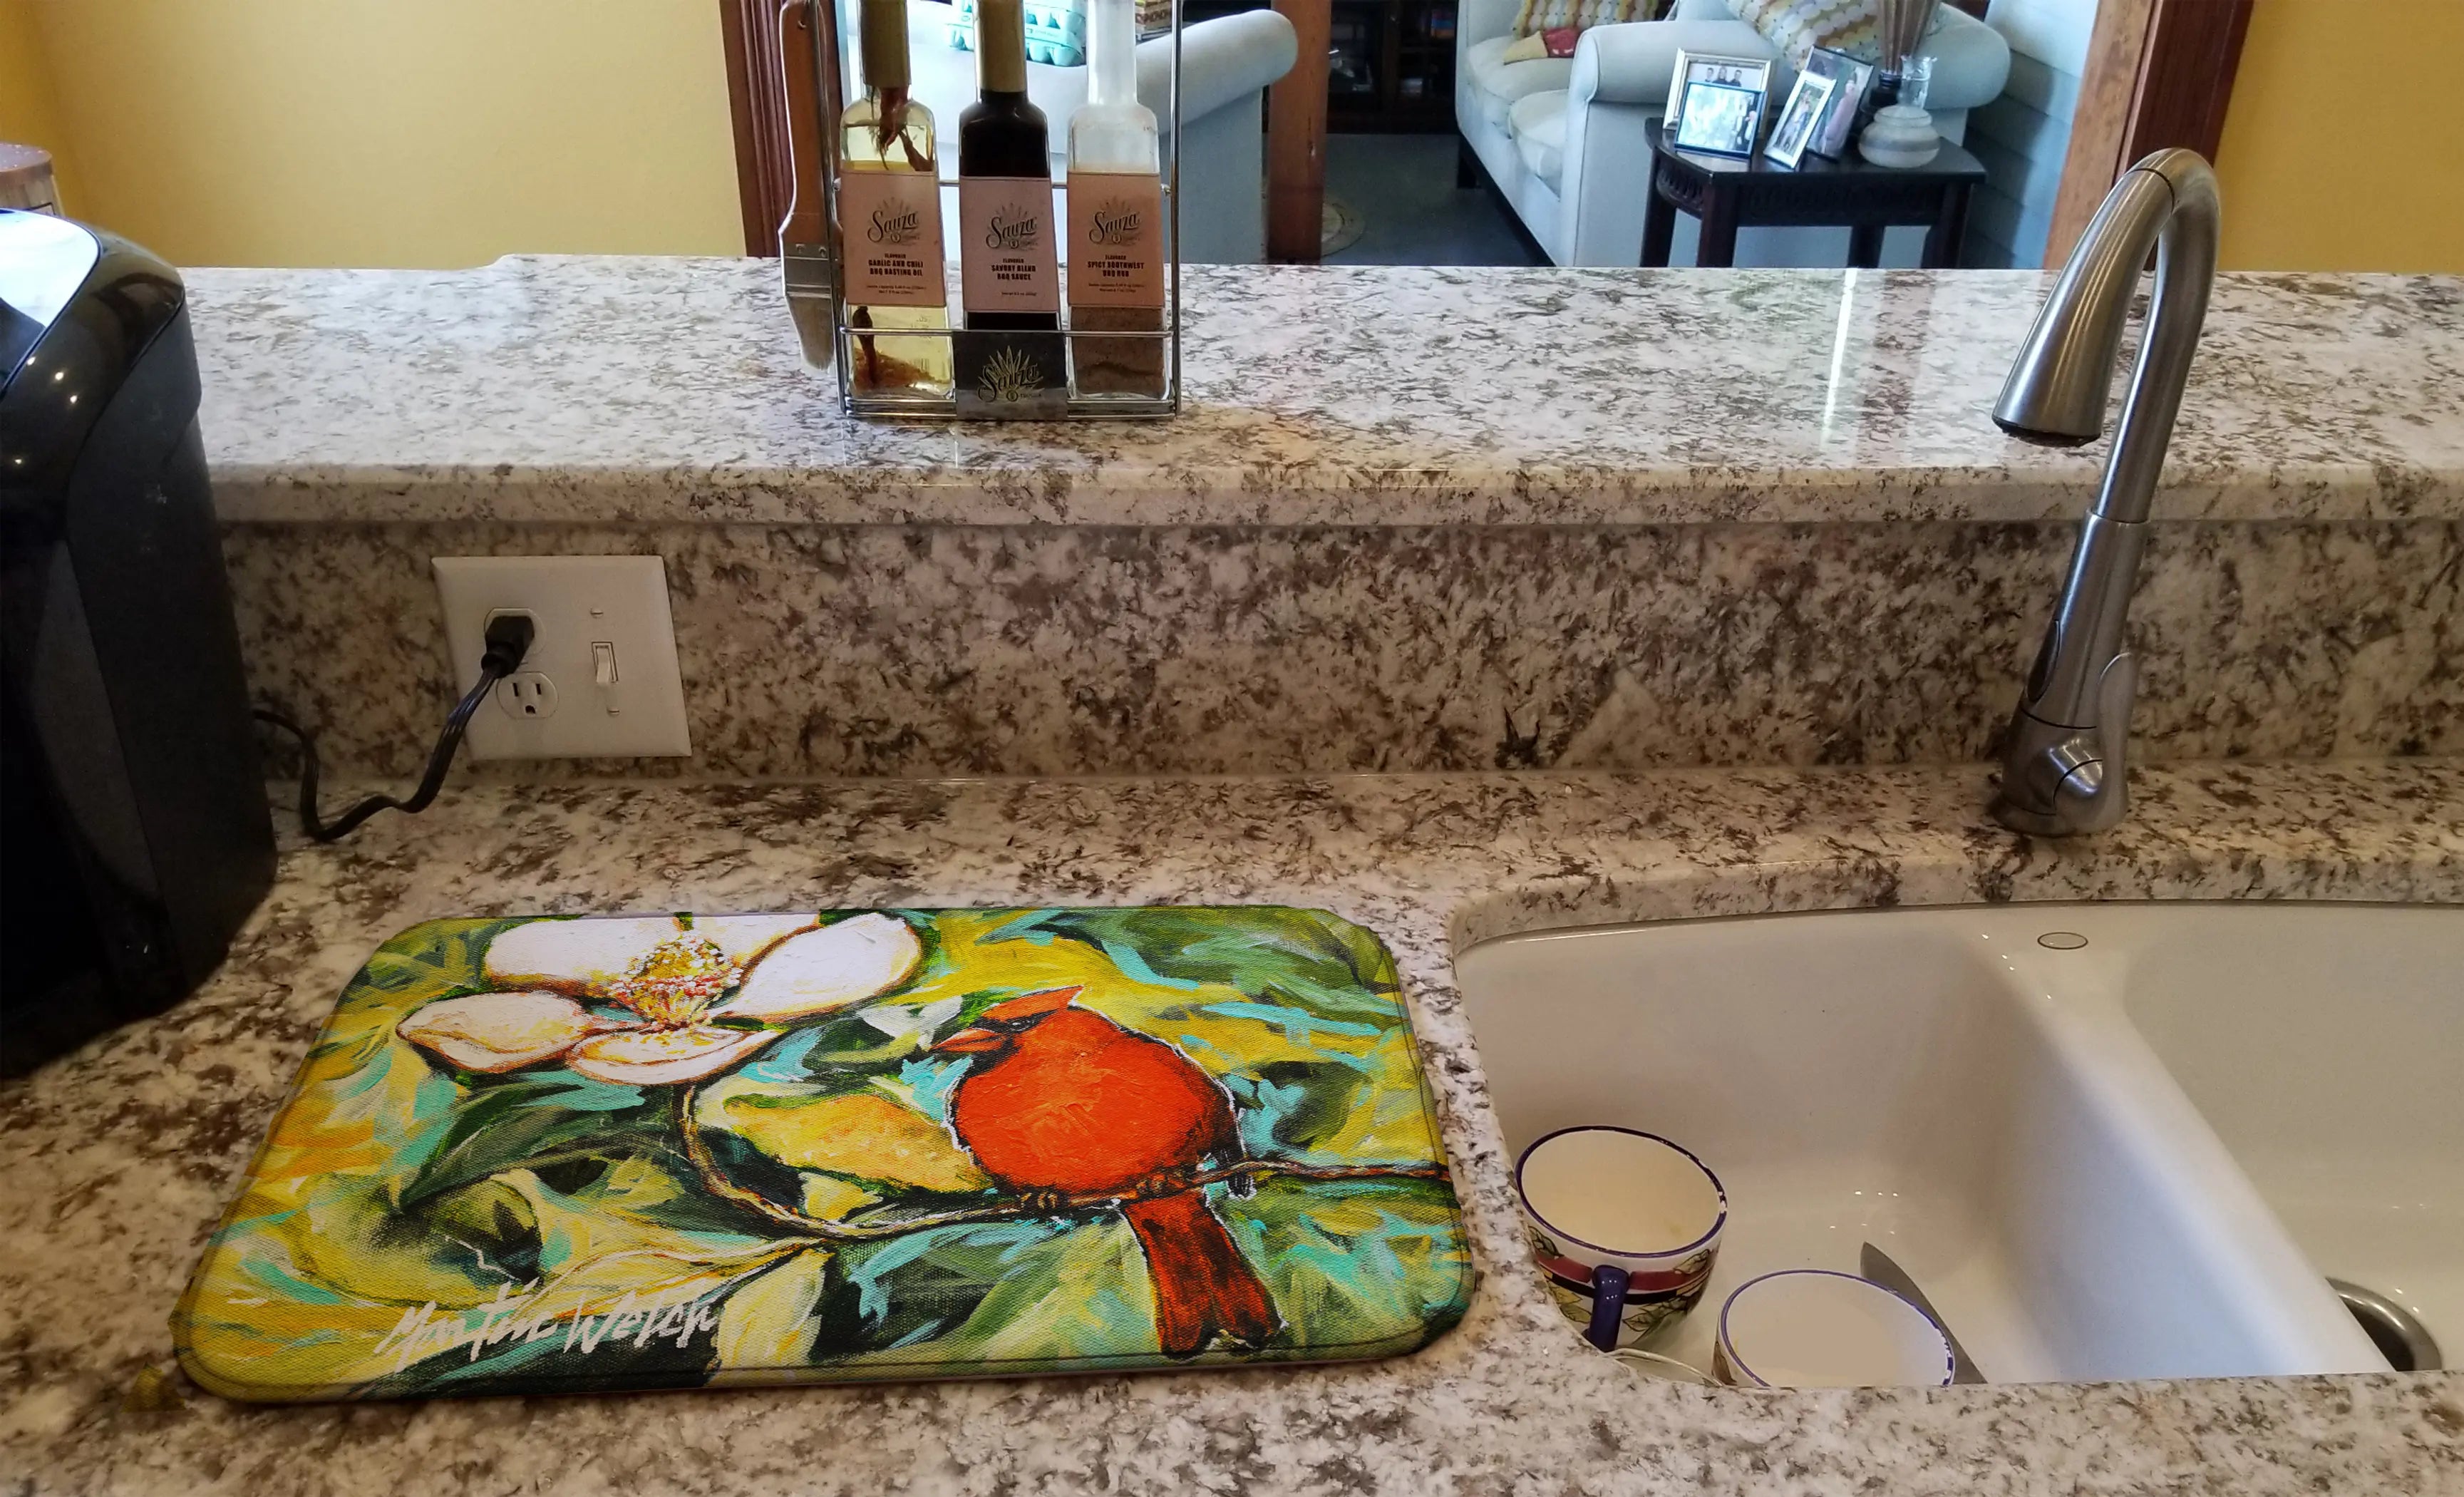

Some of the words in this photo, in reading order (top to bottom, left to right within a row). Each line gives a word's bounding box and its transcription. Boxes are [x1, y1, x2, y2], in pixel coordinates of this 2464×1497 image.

[867, 211, 918, 243] Sauza
[986, 217, 1037, 249] Sauza
[1089, 212, 1139, 245] Sauza
[977, 365, 1039, 403] Sauza
[562, 1283, 717, 1354] Welch
